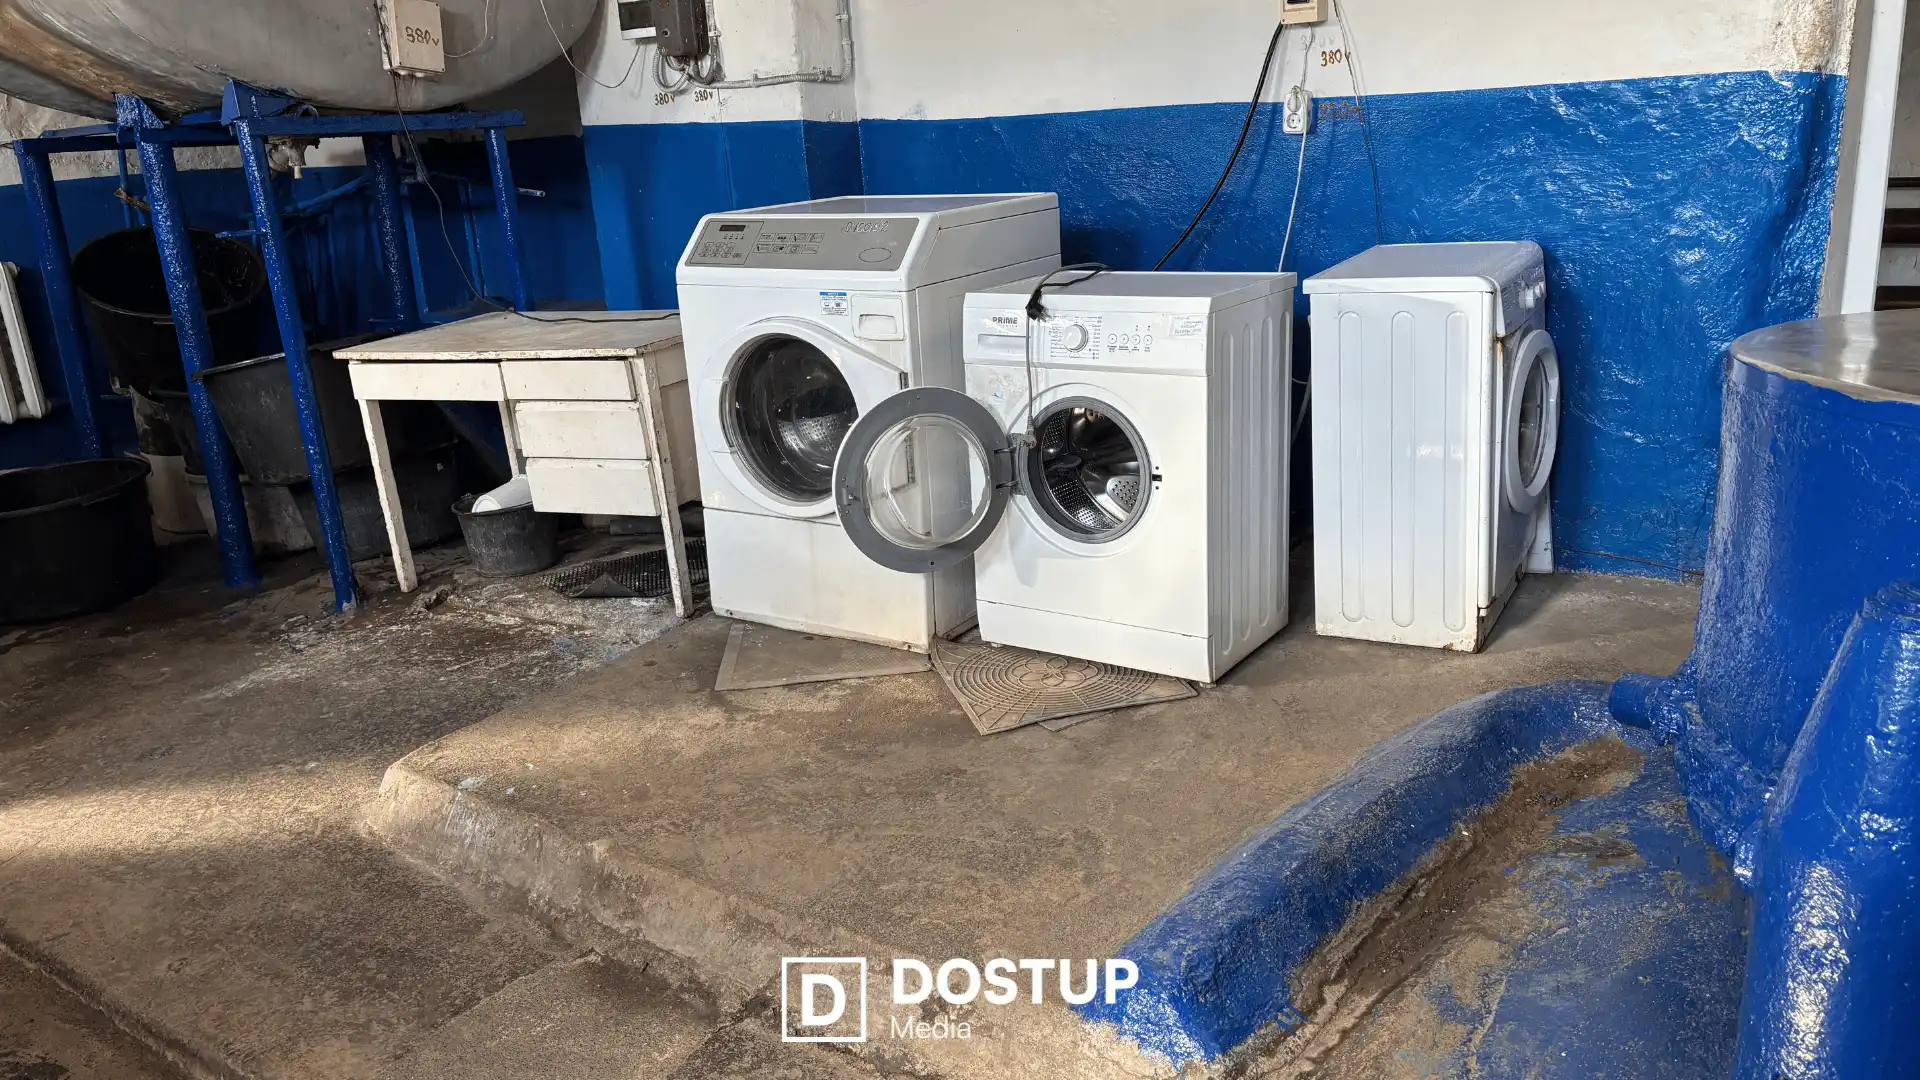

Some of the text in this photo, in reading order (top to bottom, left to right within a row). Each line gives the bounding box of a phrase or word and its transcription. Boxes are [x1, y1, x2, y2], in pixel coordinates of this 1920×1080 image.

[405, 26, 440, 47] 380v
[654, 92, 676, 106] 380v
[694, 89, 714, 103] 380v
